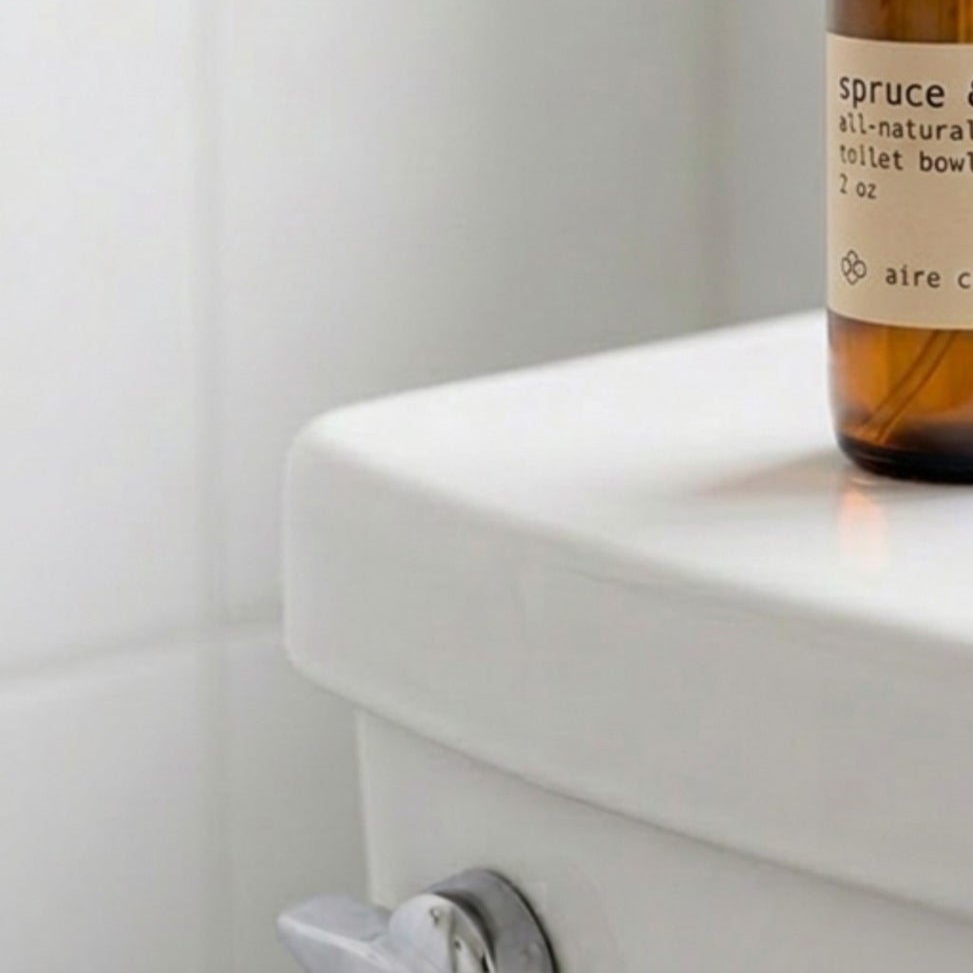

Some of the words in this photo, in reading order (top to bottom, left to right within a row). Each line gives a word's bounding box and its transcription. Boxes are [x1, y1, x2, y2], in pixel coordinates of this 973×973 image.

[839, 76, 946, 108] spruce
[839, 144, 903, 171] toilet
[839, 174, 849, 194] 2
[856, 181, 877, 200] oz
[885, 265, 941, 288] aire
